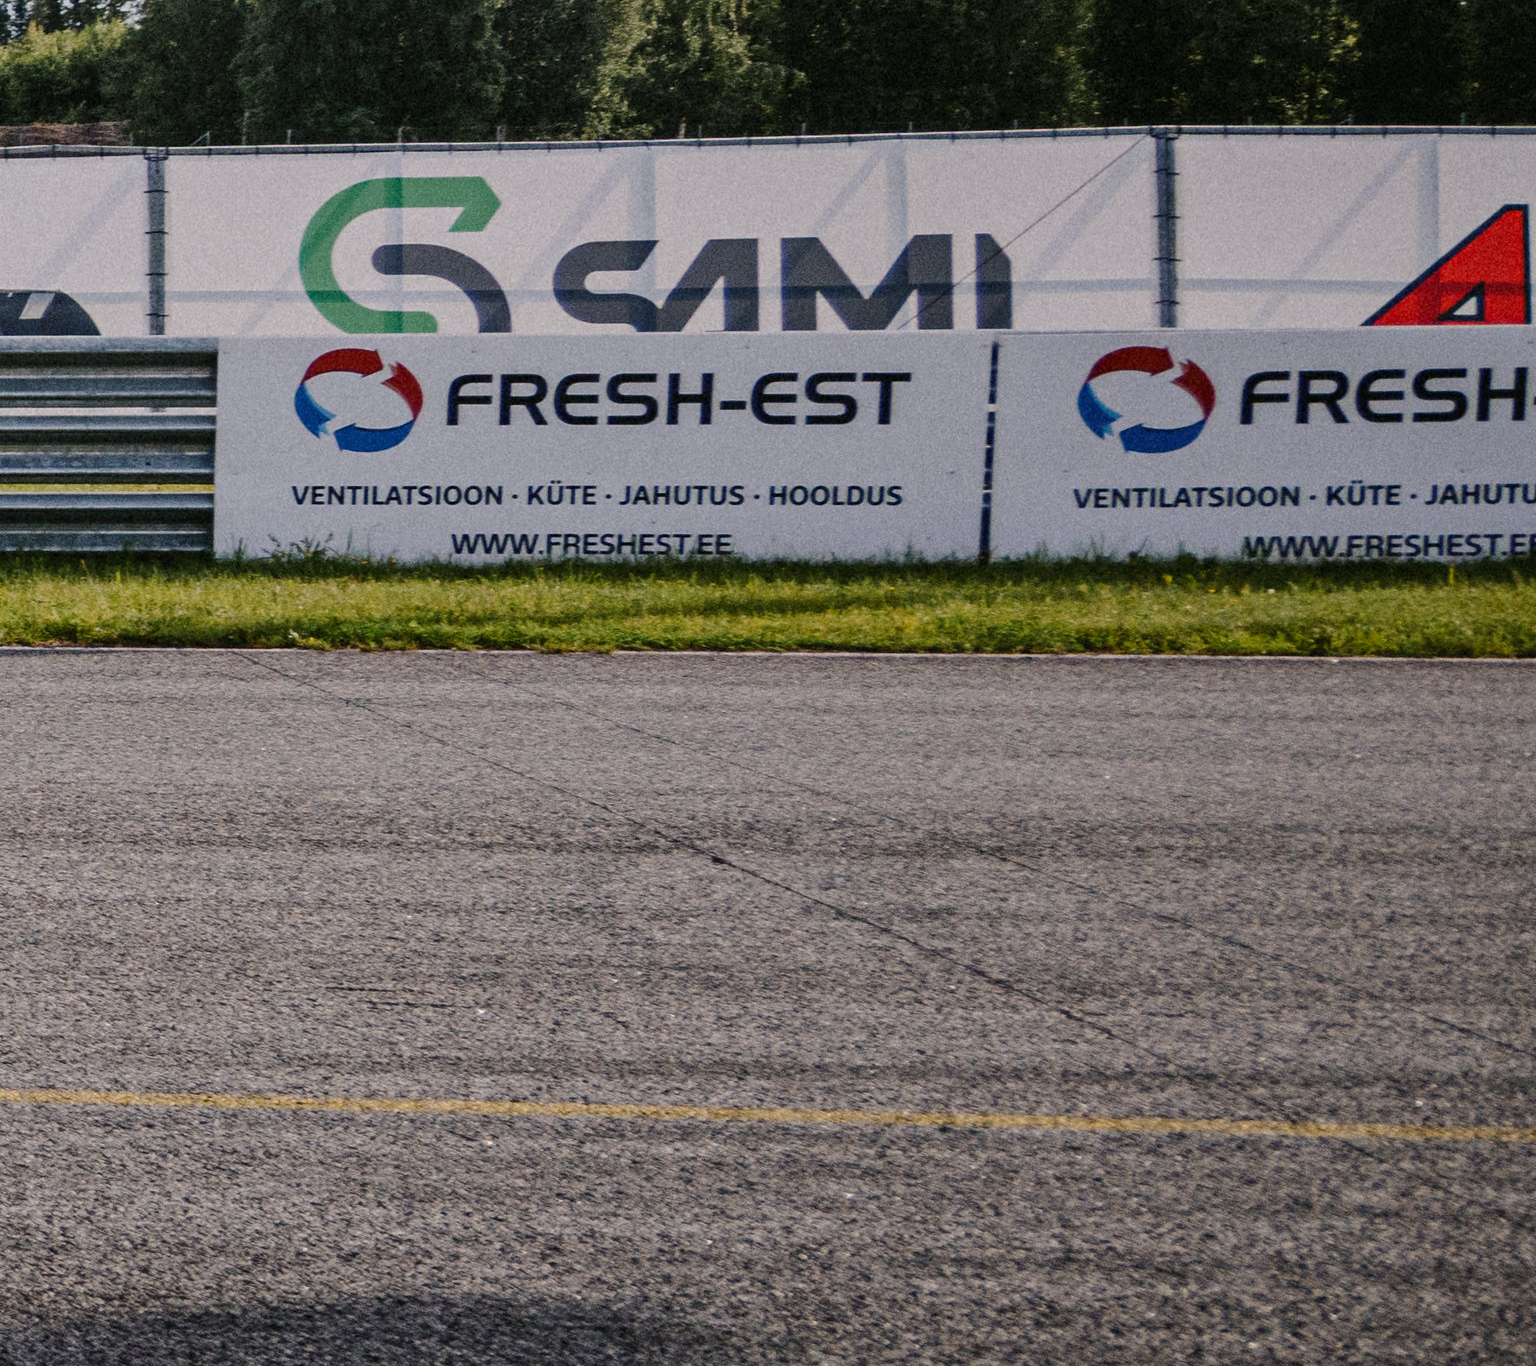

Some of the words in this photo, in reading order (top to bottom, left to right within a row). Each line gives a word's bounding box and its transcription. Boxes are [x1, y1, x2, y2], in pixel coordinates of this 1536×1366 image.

[553, 233, 1013, 332] SAMI
[446, 371, 912, 426] FRESH-EST
[1239, 367, 1536, 425] FRESH
[292, 485, 503, 507] VENTILATSIOON
[527, 479, 598, 507] KÜTE
[619, 484, 745, 507] JAHUTUS
[768, 484, 904, 507] HOOLDUS
[1073, 486, 1301, 509] VENTILATSIOON
[1325, 479, 1402, 507] KÜTE
[451, 532, 733, 557] WWW.FRESHEST.EE
